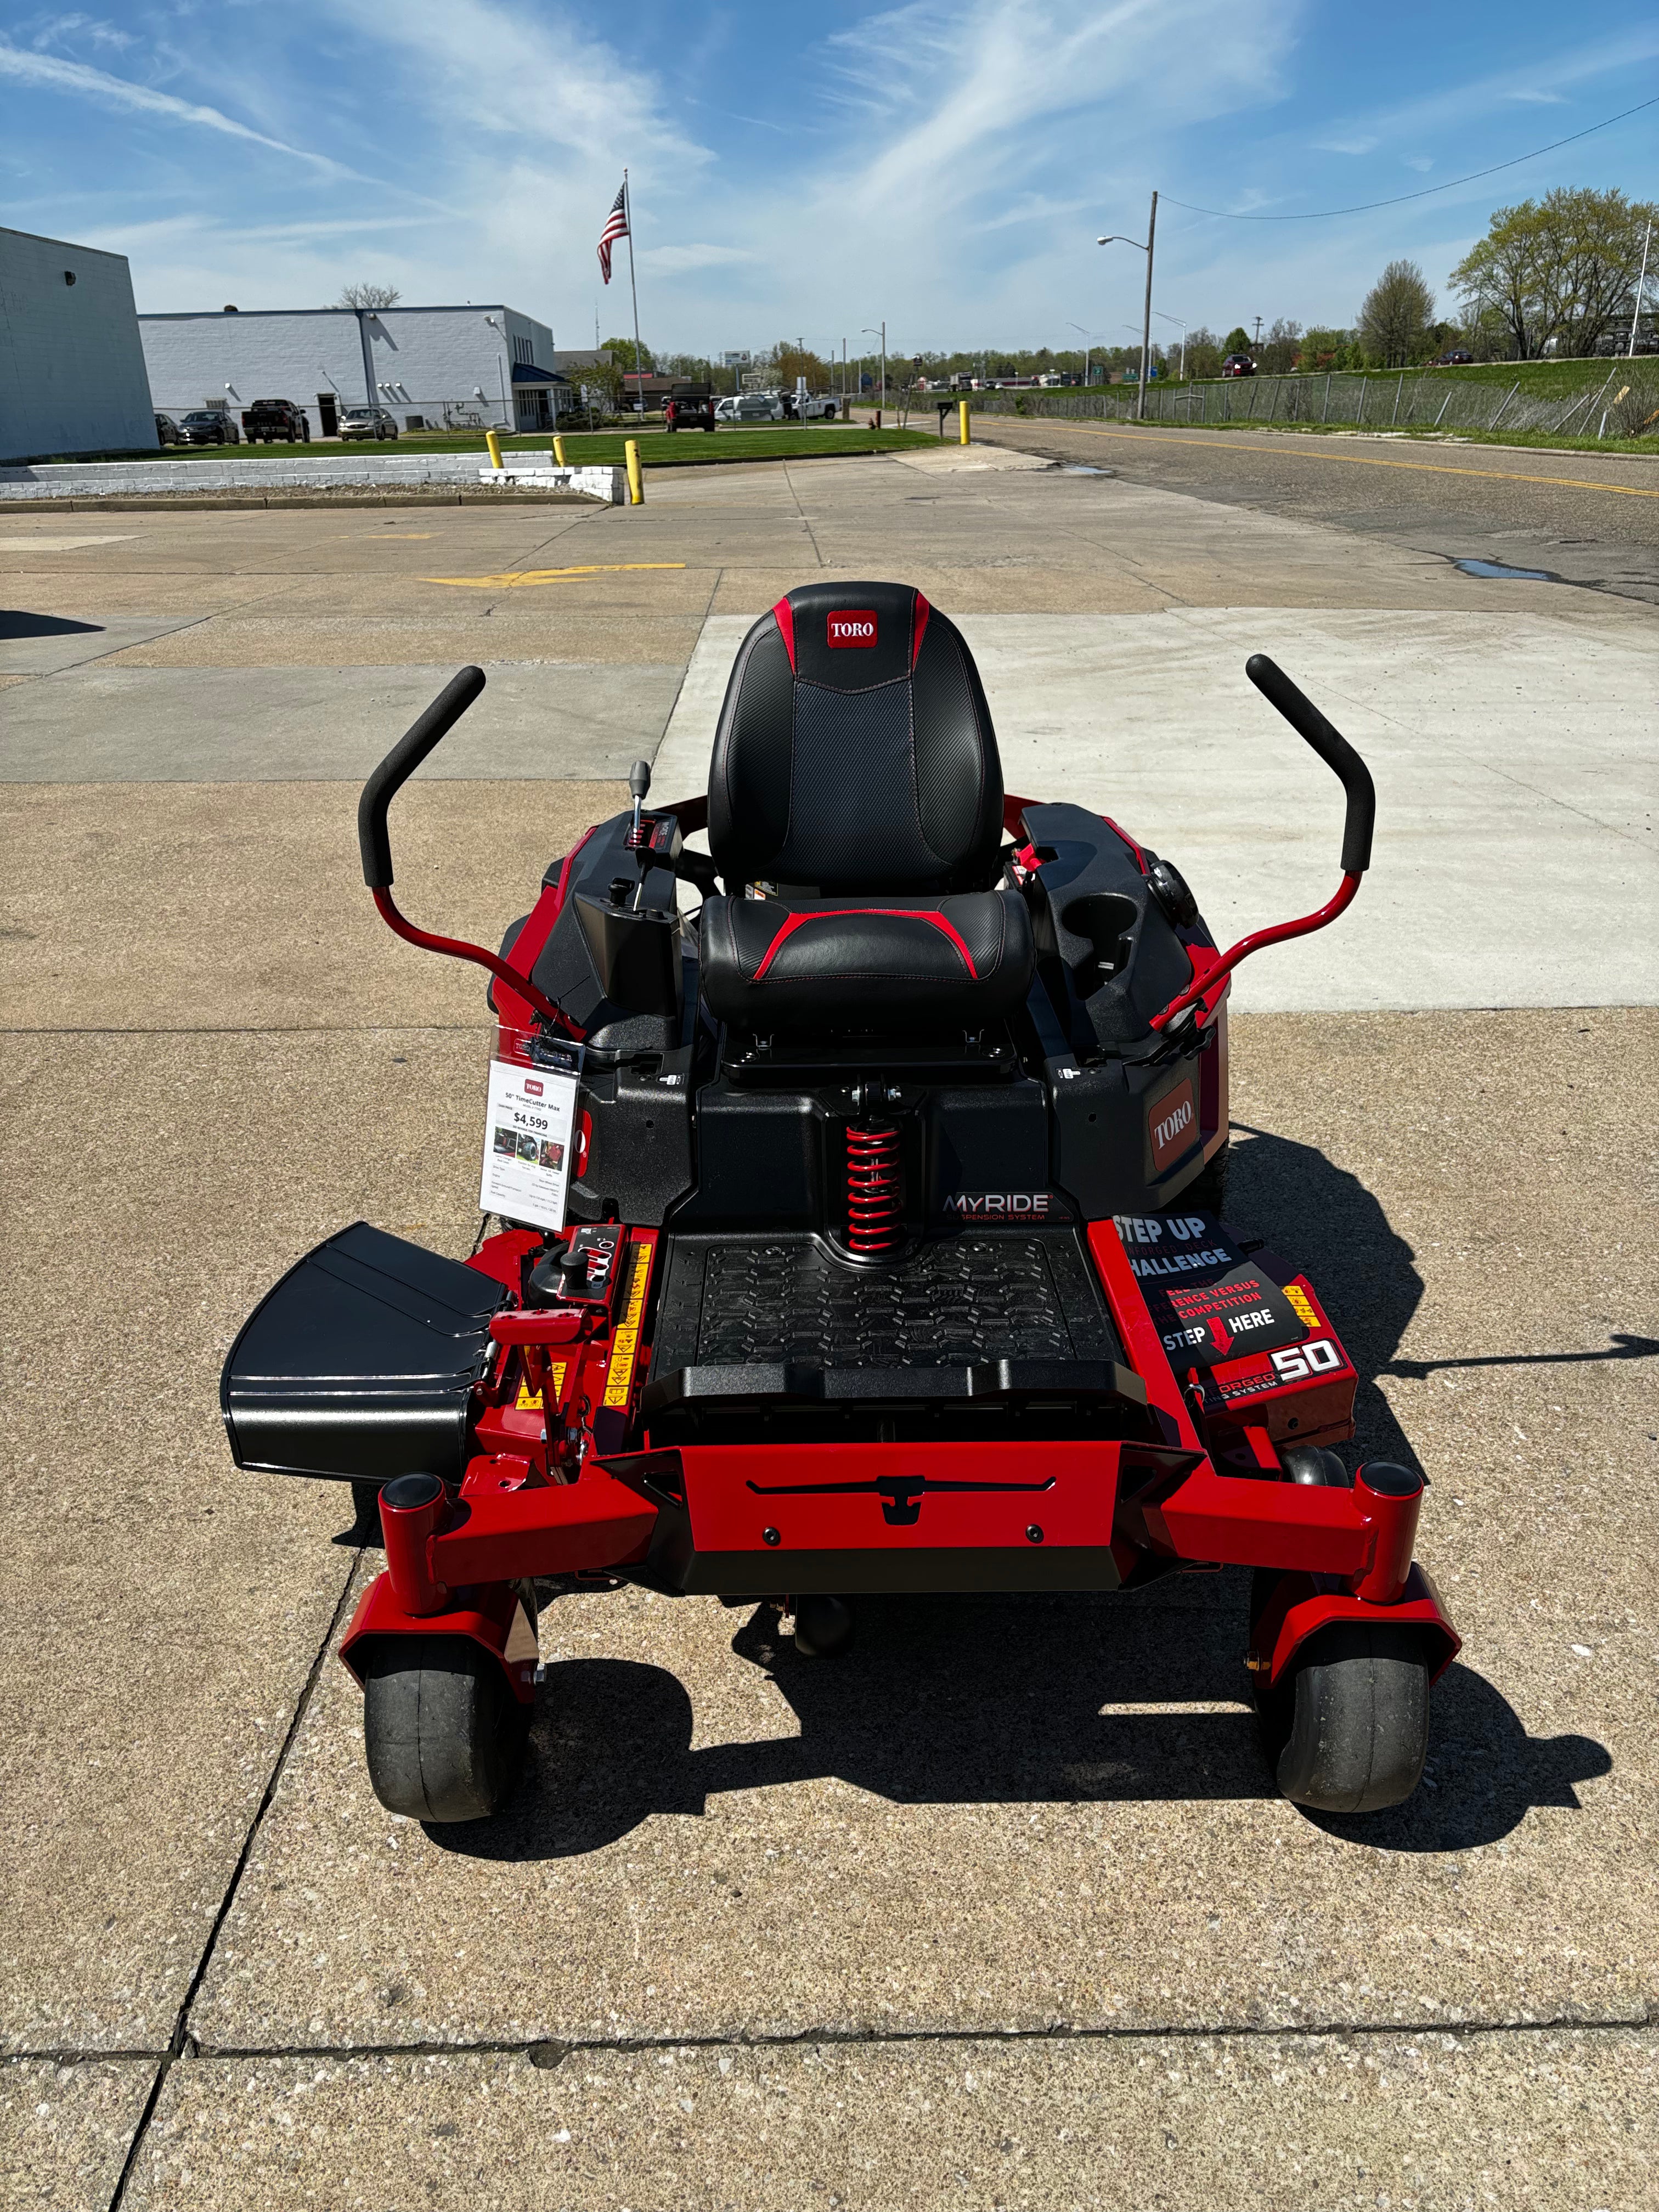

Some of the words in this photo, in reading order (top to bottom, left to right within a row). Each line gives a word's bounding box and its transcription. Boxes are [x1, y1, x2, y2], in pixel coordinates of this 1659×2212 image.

[831, 623, 874, 637] TORO
[526, 1083, 541, 1092] TORO
[516, 1095, 547, 1108] TimeCutter
[514, 1112, 548, 1130] $4,599
[1154, 1101, 1191, 1150] TORO
[1113, 1215, 1162, 1243] STEP
[1166, 1217, 1206, 1240] UP
[1125, 1245, 1177, 1256] NFORGED
[1185, 1239, 1218, 1251] DECK
[1129, 1248, 1232, 1277] HALLENGE
[1159, 1285, 1190, 1297] FEEL
[1190, 1278, 1217, 1289] THE
[1210, 1279, 1260, 1297] VERSUS
[1178, 1291, 1262, 1319] COMPETITION
[1163, 1327, 1205, 1351] STEP
[1228, 1308, 1274, 1333] HERE
[1271, 1340, 1340, 1381] 50
[1204, 1393, 1230, 1404] TING
[1231, 1381, 1278, 1396] SYSTEM
[1206, 1373, 1275, 1396] FORGED
